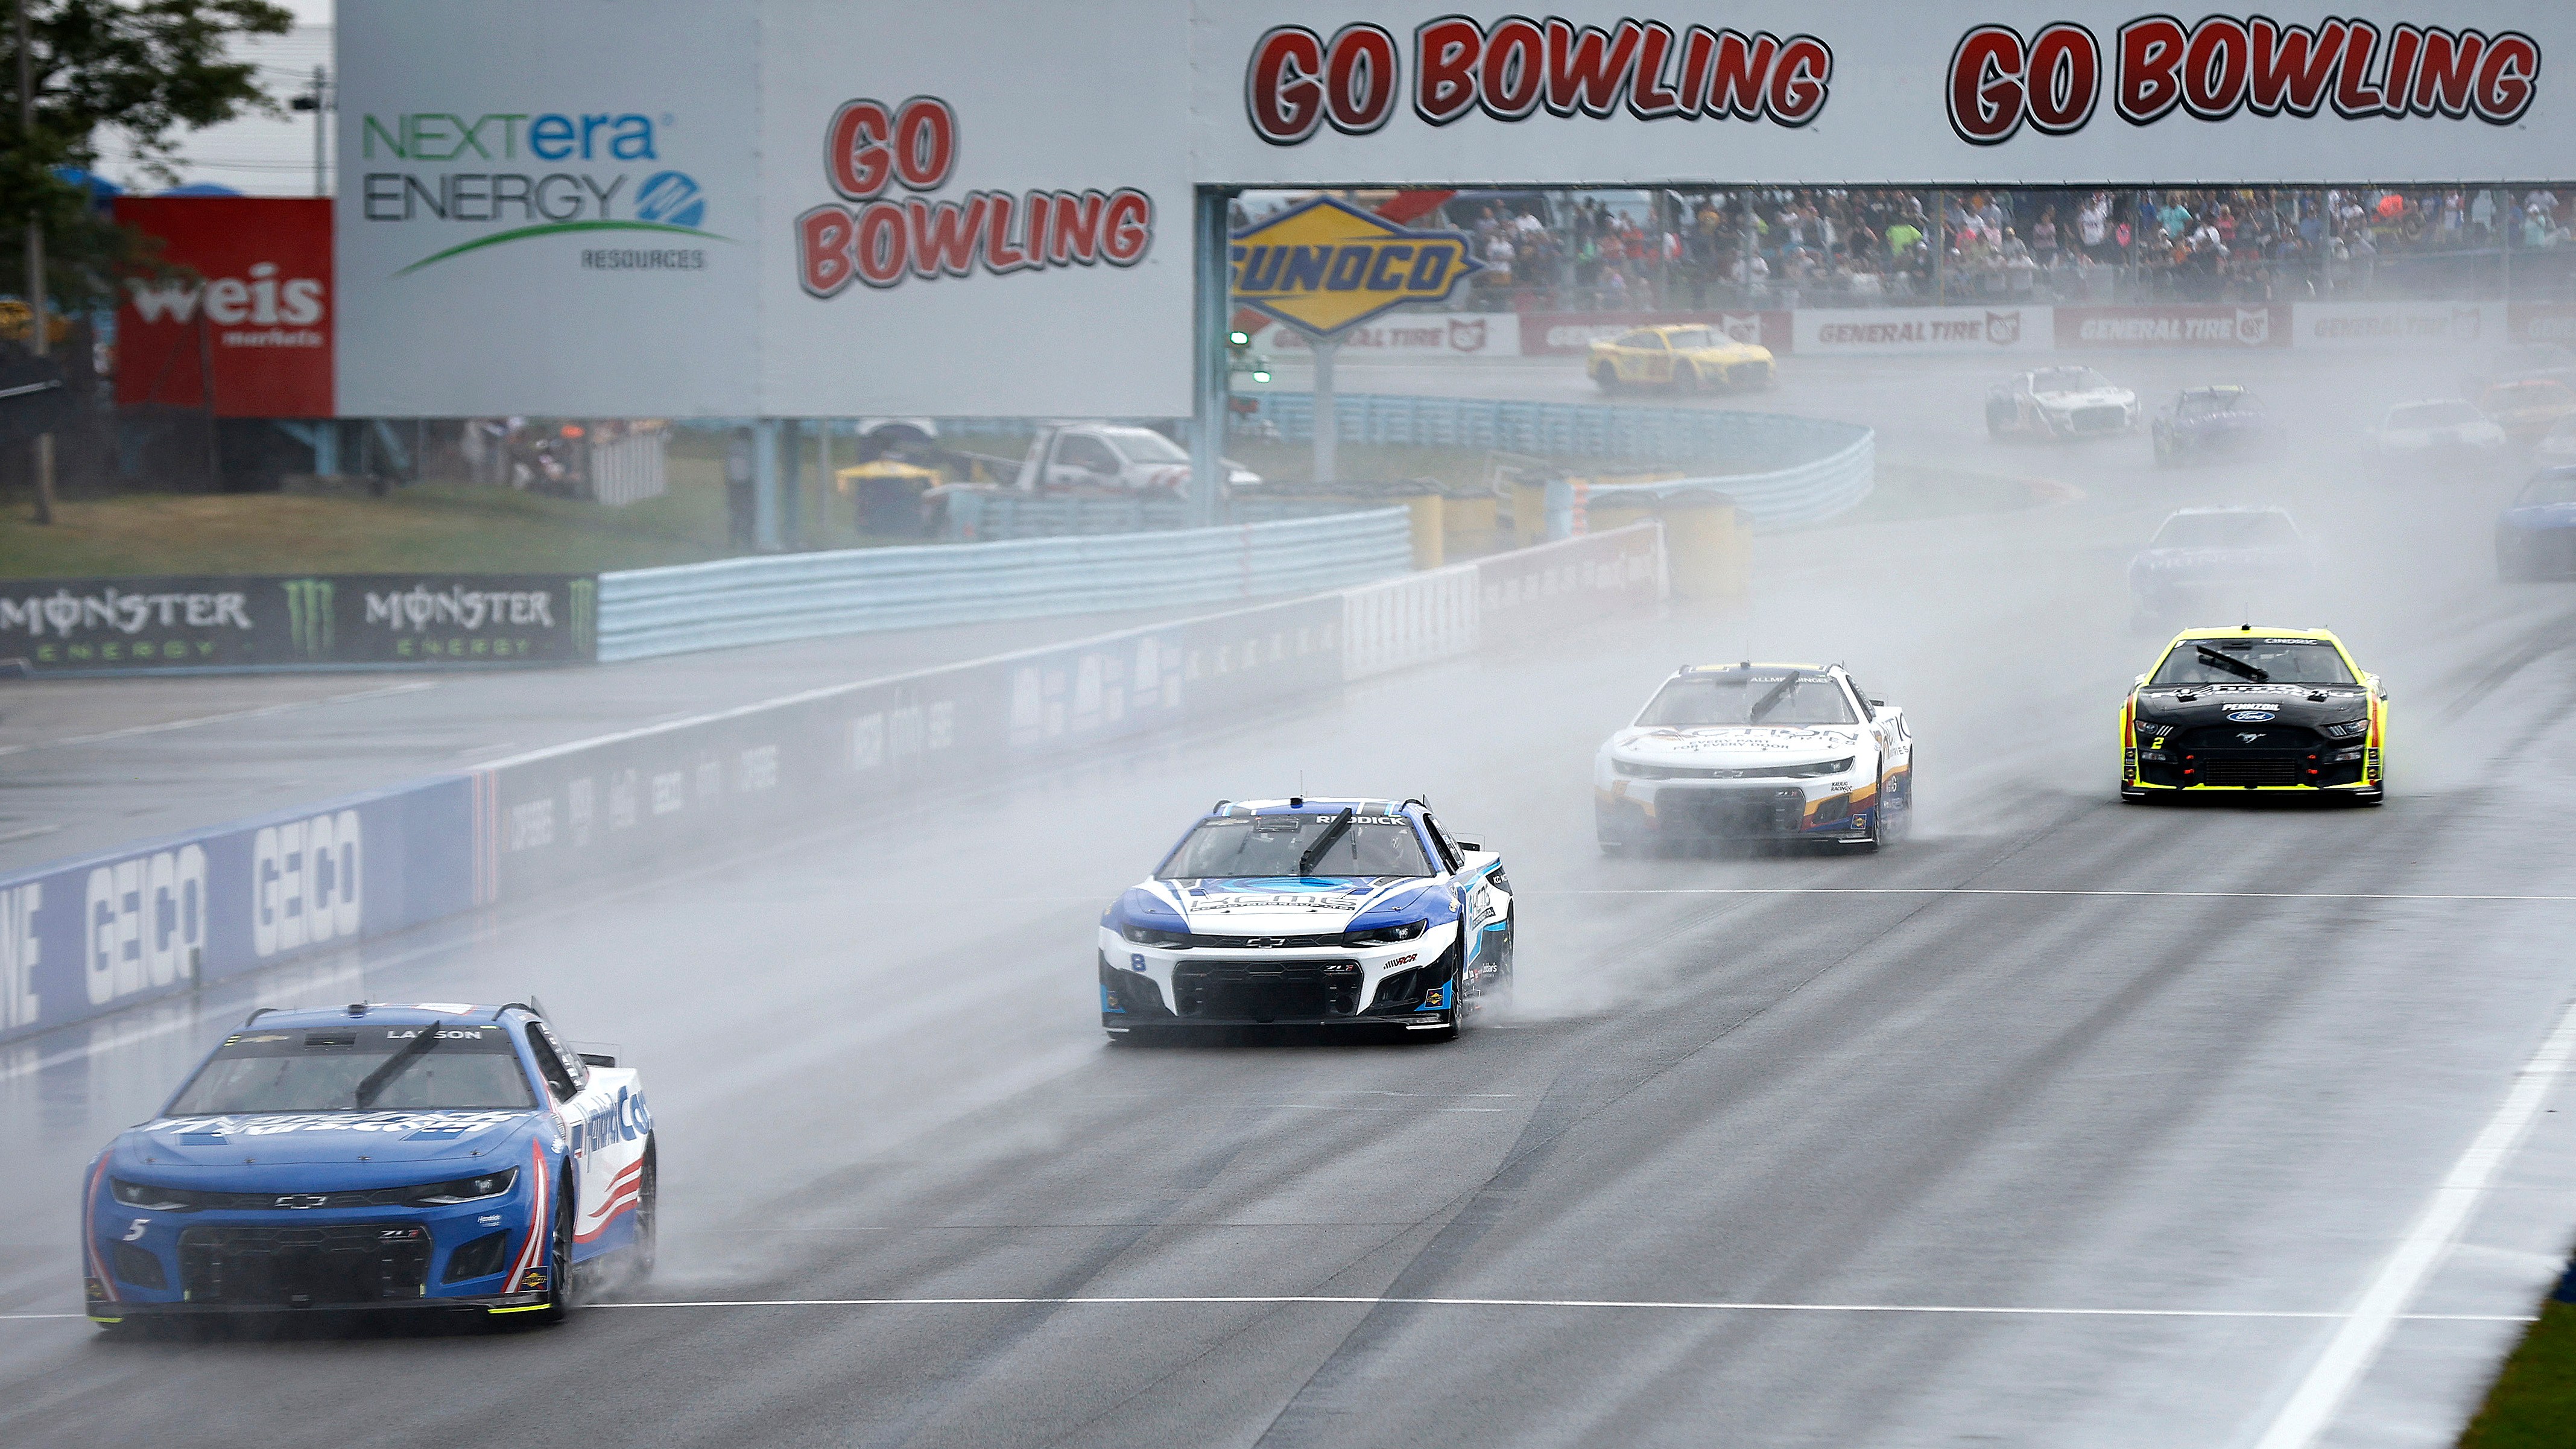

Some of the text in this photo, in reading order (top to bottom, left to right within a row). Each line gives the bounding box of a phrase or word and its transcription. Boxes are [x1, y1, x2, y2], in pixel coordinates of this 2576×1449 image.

[1244, 13, 1832, 146] GO BOWLING
[1946, 14, 2541, 145] GO BOWLING
[362, 113, 657, 161] NEXTera
[823, 95, 961, 202] GO
[364, 173, 627, 222] ENERGY
[581, 250, 705, 270] RESOURCES
[794, 186, 1155, 299] BOWLING
[122, 262, 324, 327] weis
[1819, 320, 1984, 344] GENERAL TIRE
[2080, 317, 2233, 341] GENERAL TIRE
[0, 588, 253, 638] MONSTER
[365, 583, 555, 632] MONSTER
[2221, 703, 2280, 711] PENNZOIL
[2235, 712, 2266, 721] Ford
[2151, 737, 2165, 749] 2
[253, 810, 361, 957] GEICO
[86, 844, 209, 1005] GEICO
[1131, 953, 1147, 972] 8
[387, 1030, 481, 1039] LASON
[122, 1219, 152, 1241] 5
